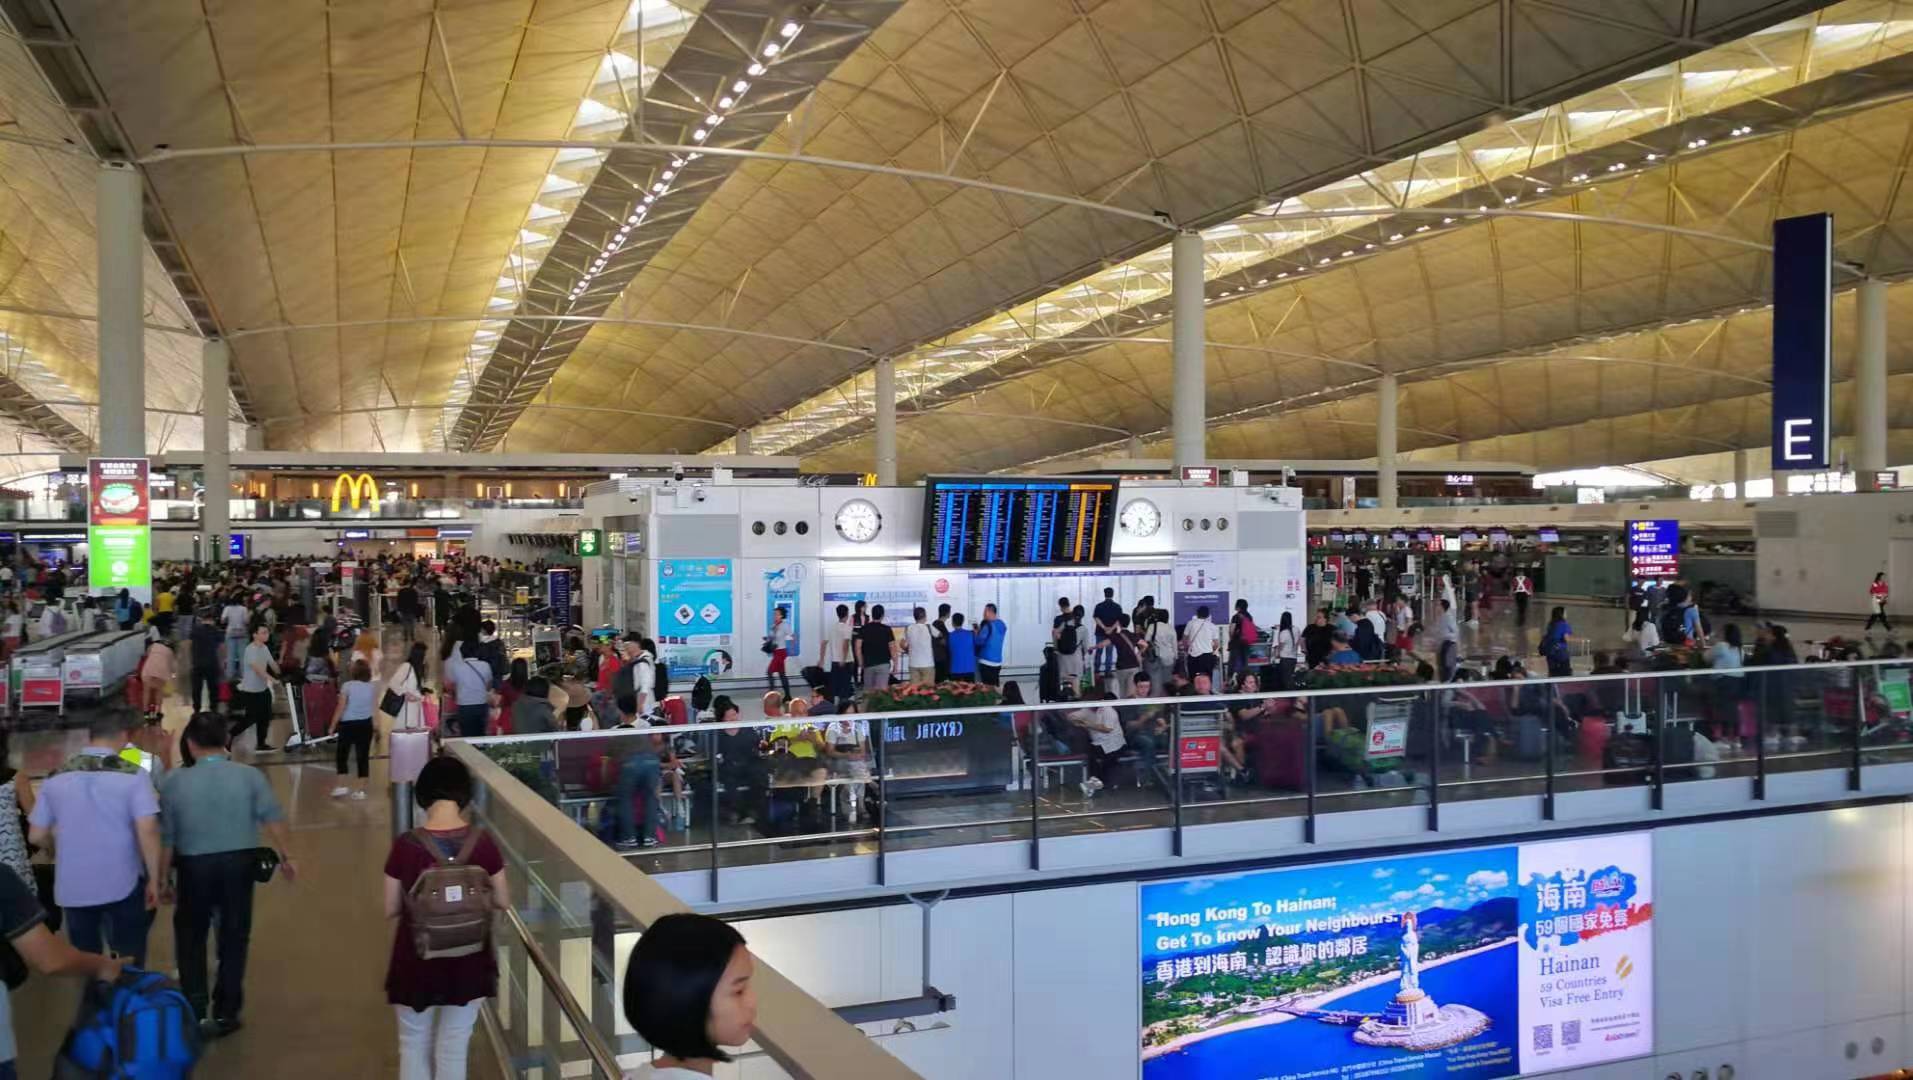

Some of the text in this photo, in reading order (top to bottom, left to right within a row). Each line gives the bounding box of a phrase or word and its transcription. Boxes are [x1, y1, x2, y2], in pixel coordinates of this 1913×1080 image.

[1784, 418, 1813, 460] E
[1536, 880, 1586, 912] 海南
[1156, 911, 1200, 927] Hong
[1205, 906, 1247, 921] Kong
[1252, 901, 1272, 916] To
[1156, 910, 1398, 950] Get To know Your Neighbours.
[1540, 954, 1600, 976] Hainan
[1540, 976, 1607, 993] 59 Countries
[1540, 988, 1624, 1008] Visa Free Entry
